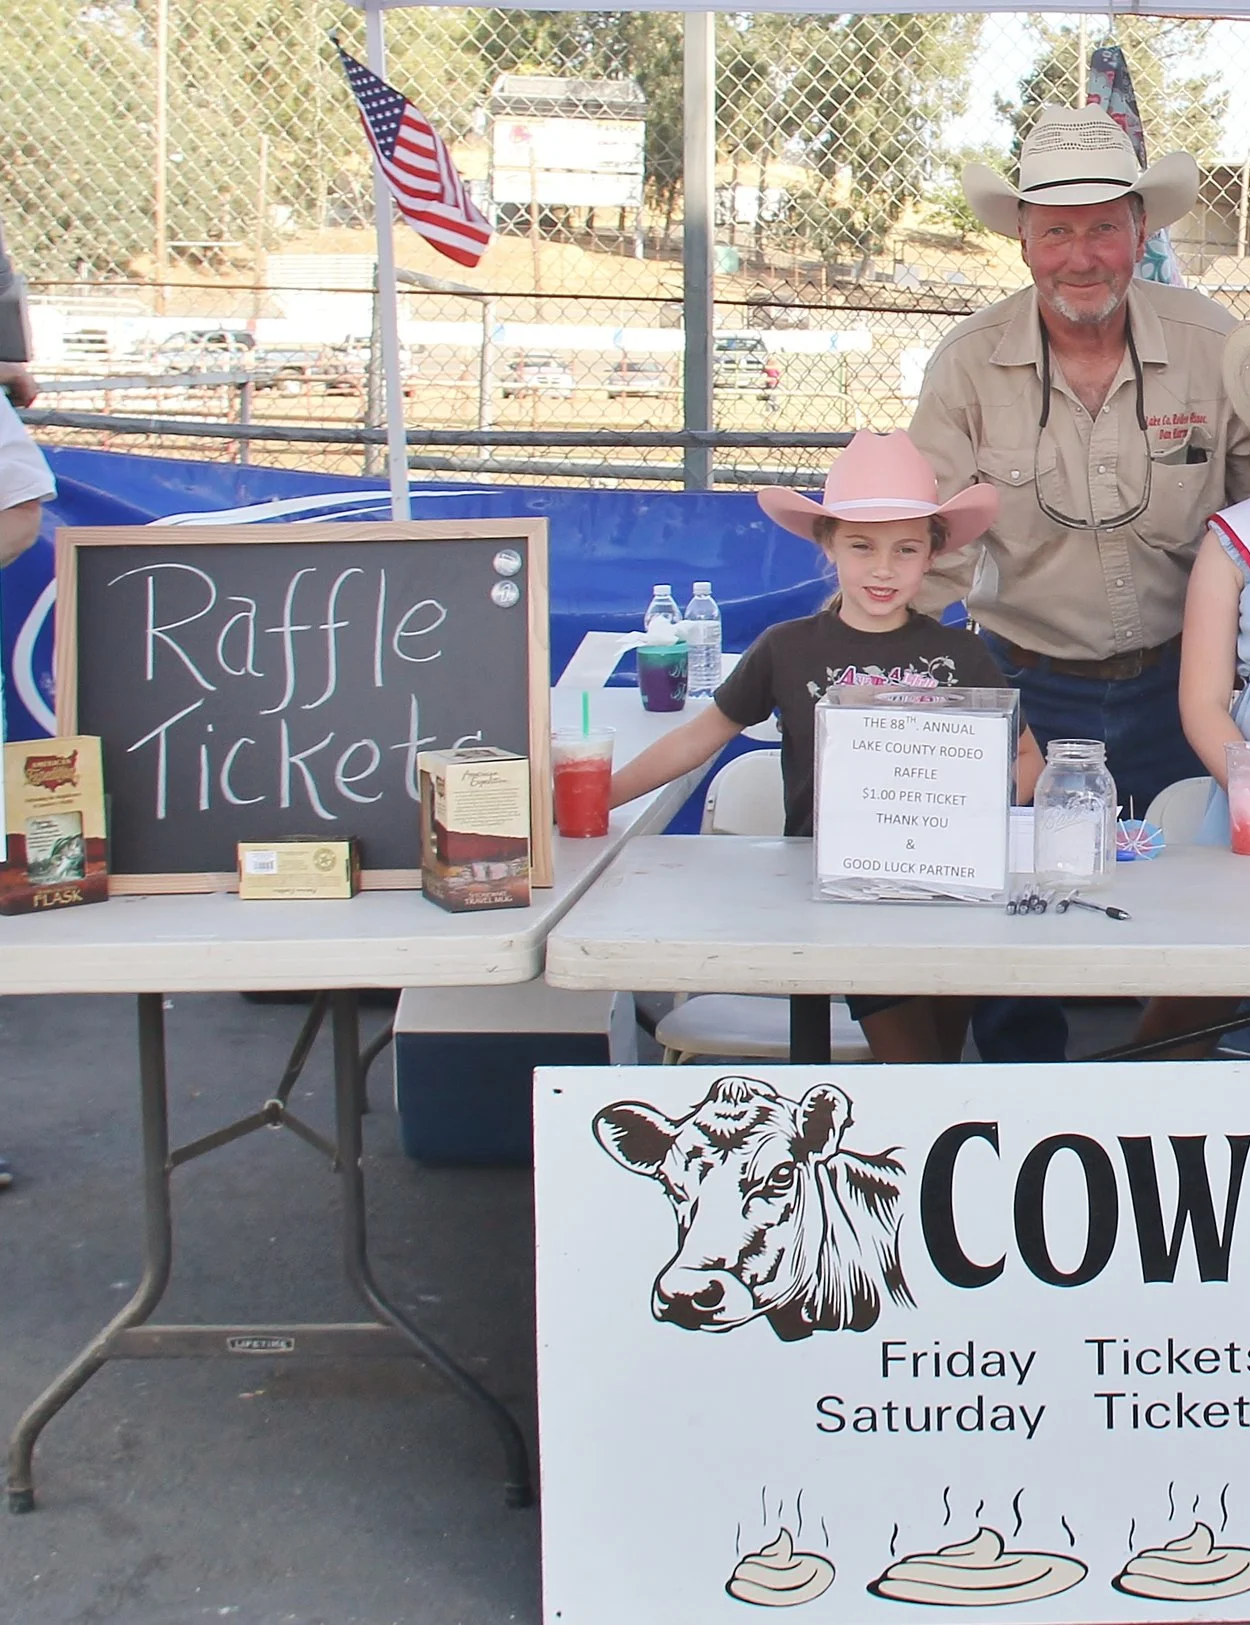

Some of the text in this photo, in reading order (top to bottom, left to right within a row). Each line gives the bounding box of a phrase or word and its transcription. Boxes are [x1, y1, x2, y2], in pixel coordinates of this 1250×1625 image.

[107, 562, 448, 716] Raffle
[863, 716, 887, 730] THE
[922, 720, 977, 737] ANNUAL
[126, 693, 483, 822] Ticket
[851, 738, 984, 761] LAKE COUNTY RODEO
[893, 766, 939, 781] RAFFLE
[861, 786, 968, 807] $1.00 PER TICKET
[876, 812, 950, 829] THANK YOU
[905, 838, 916, 851] &
[842, 857, 976, 879] GOOD LUCK PARTNER
[33, 889, 84, 908] FLASK
[881, 1340, 1037, 1386] Friday
[815, 1394, 1047, 1440] Saturday
